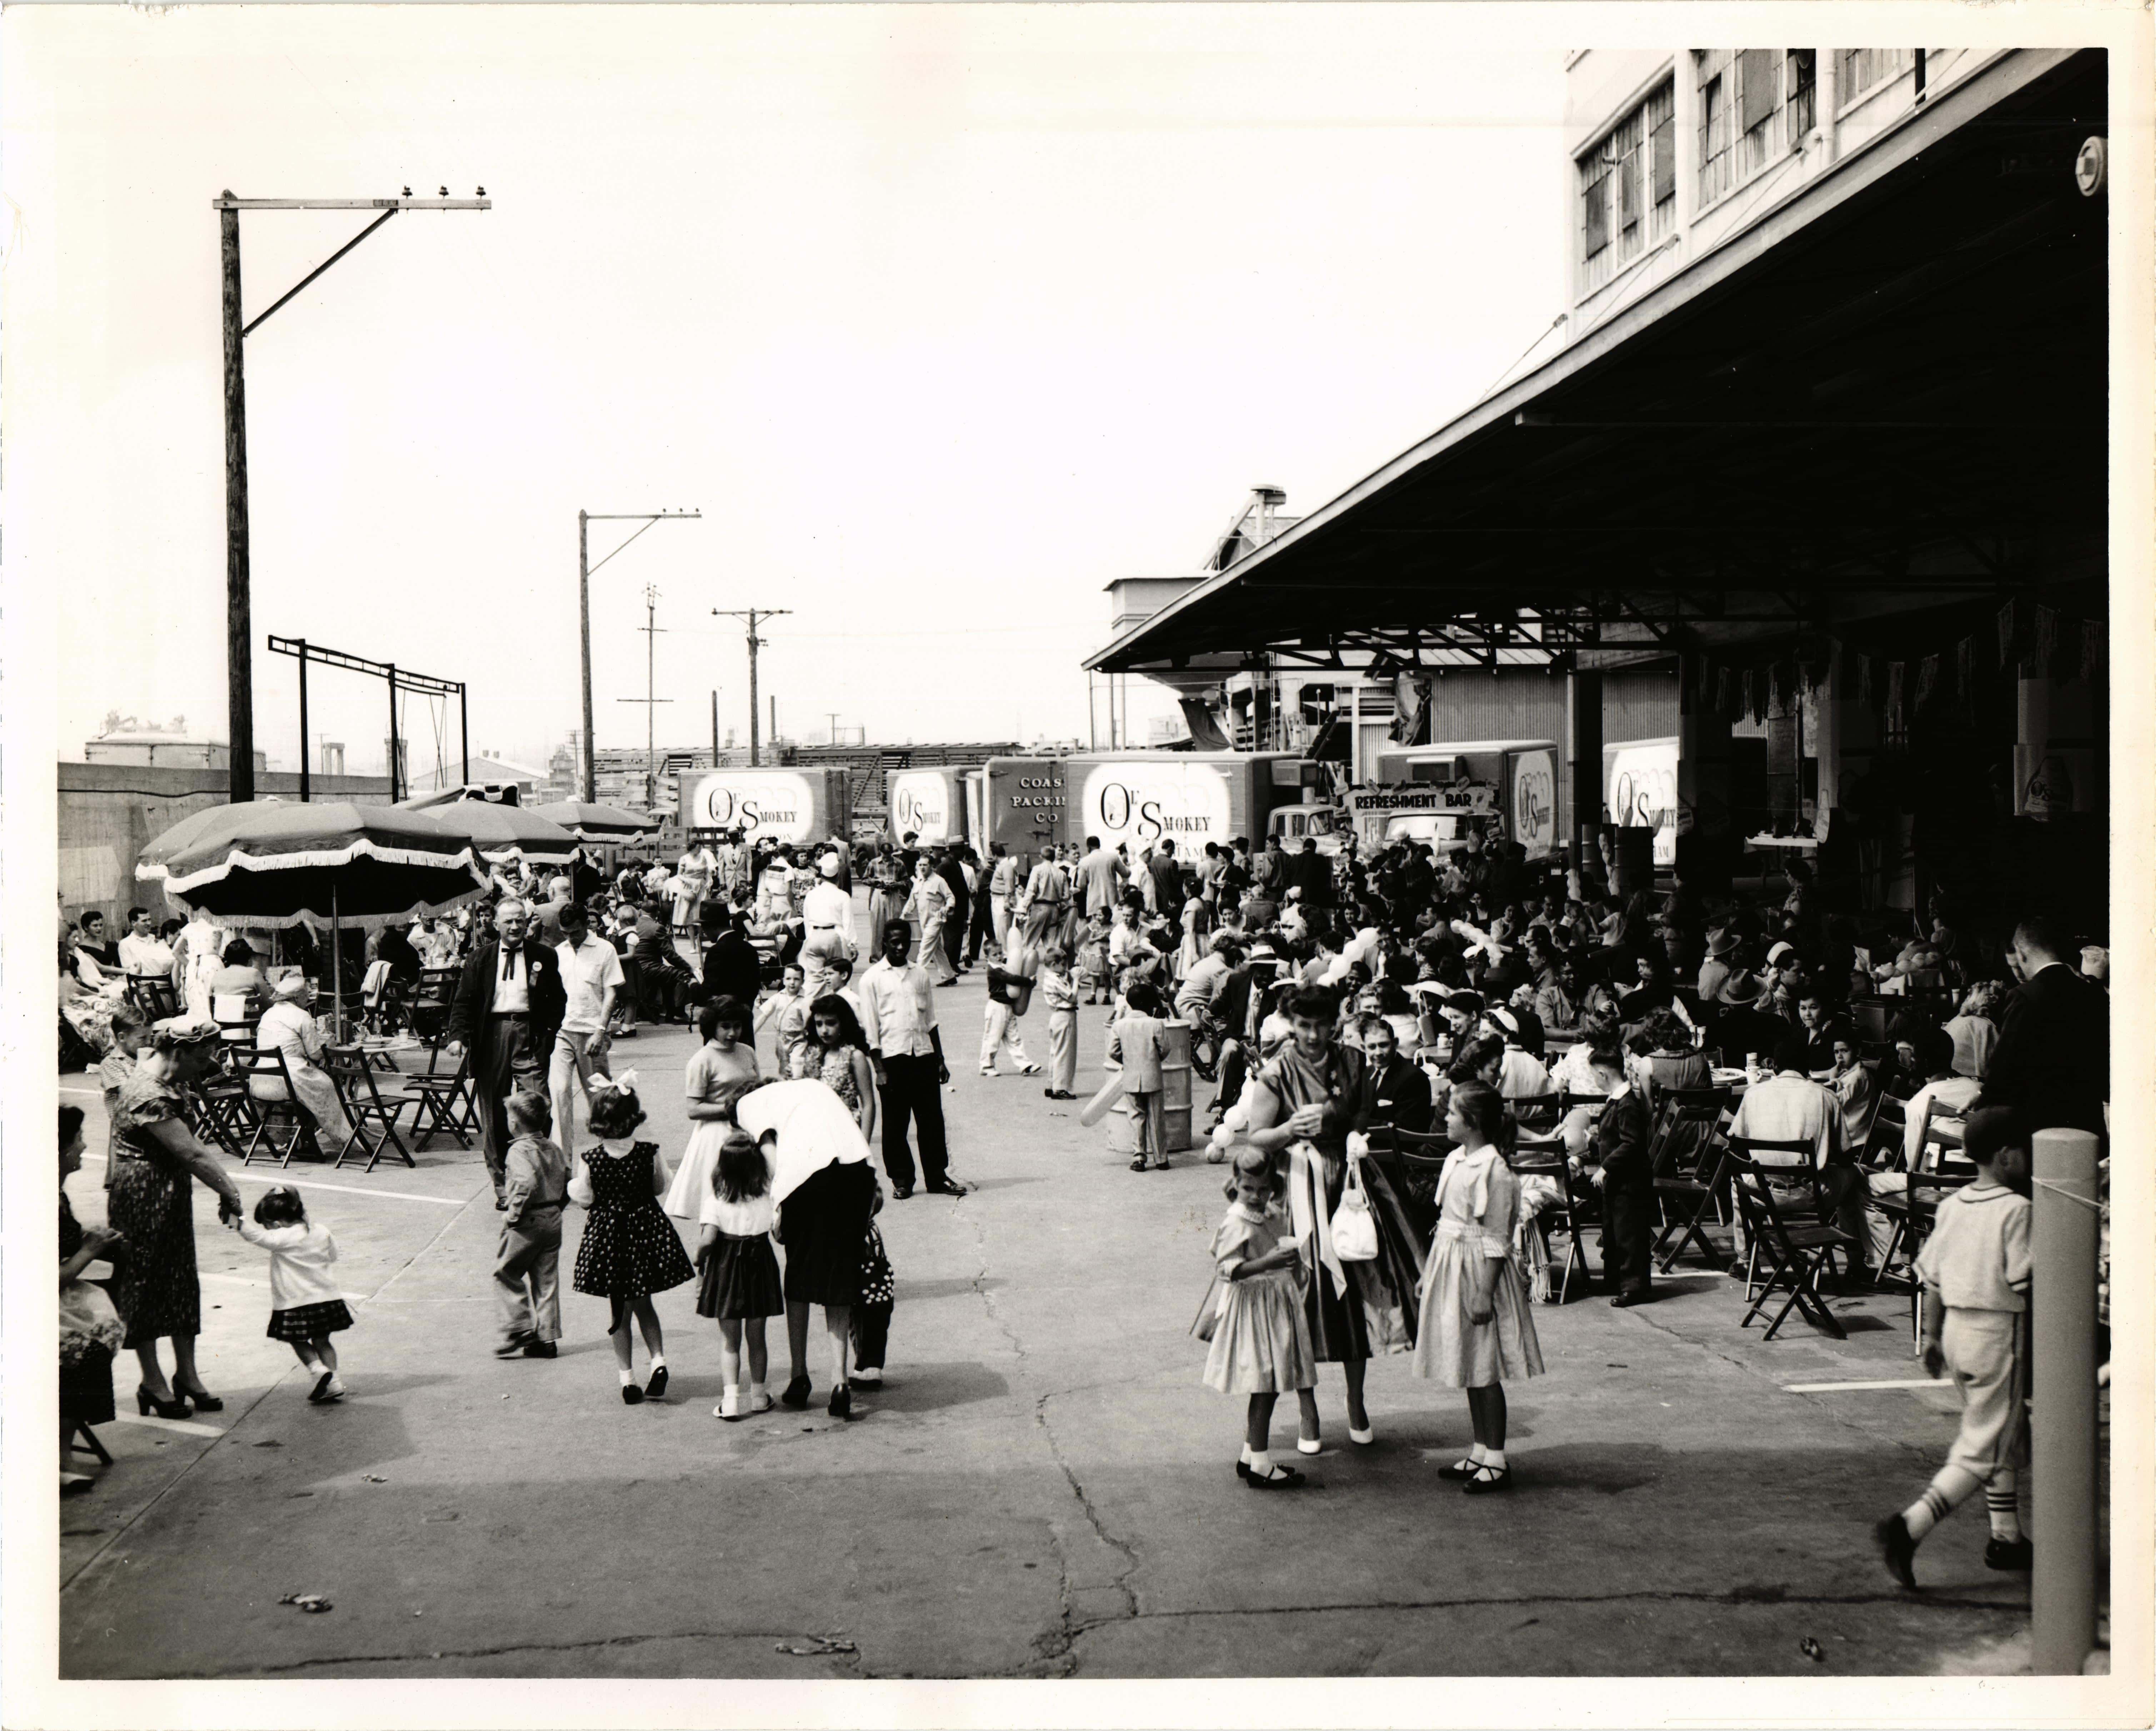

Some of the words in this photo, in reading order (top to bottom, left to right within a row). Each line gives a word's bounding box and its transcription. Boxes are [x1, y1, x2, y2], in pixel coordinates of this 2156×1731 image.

[1020, 778, 1064, 788] COAS
[1355, 794, 1437, 809] REFRESHMENT
[1445, 793, 1472, 807] BAR
[739, 800, 798, 830] SMOKEY
[1138, 802, 1211, 840] SMOKEY
